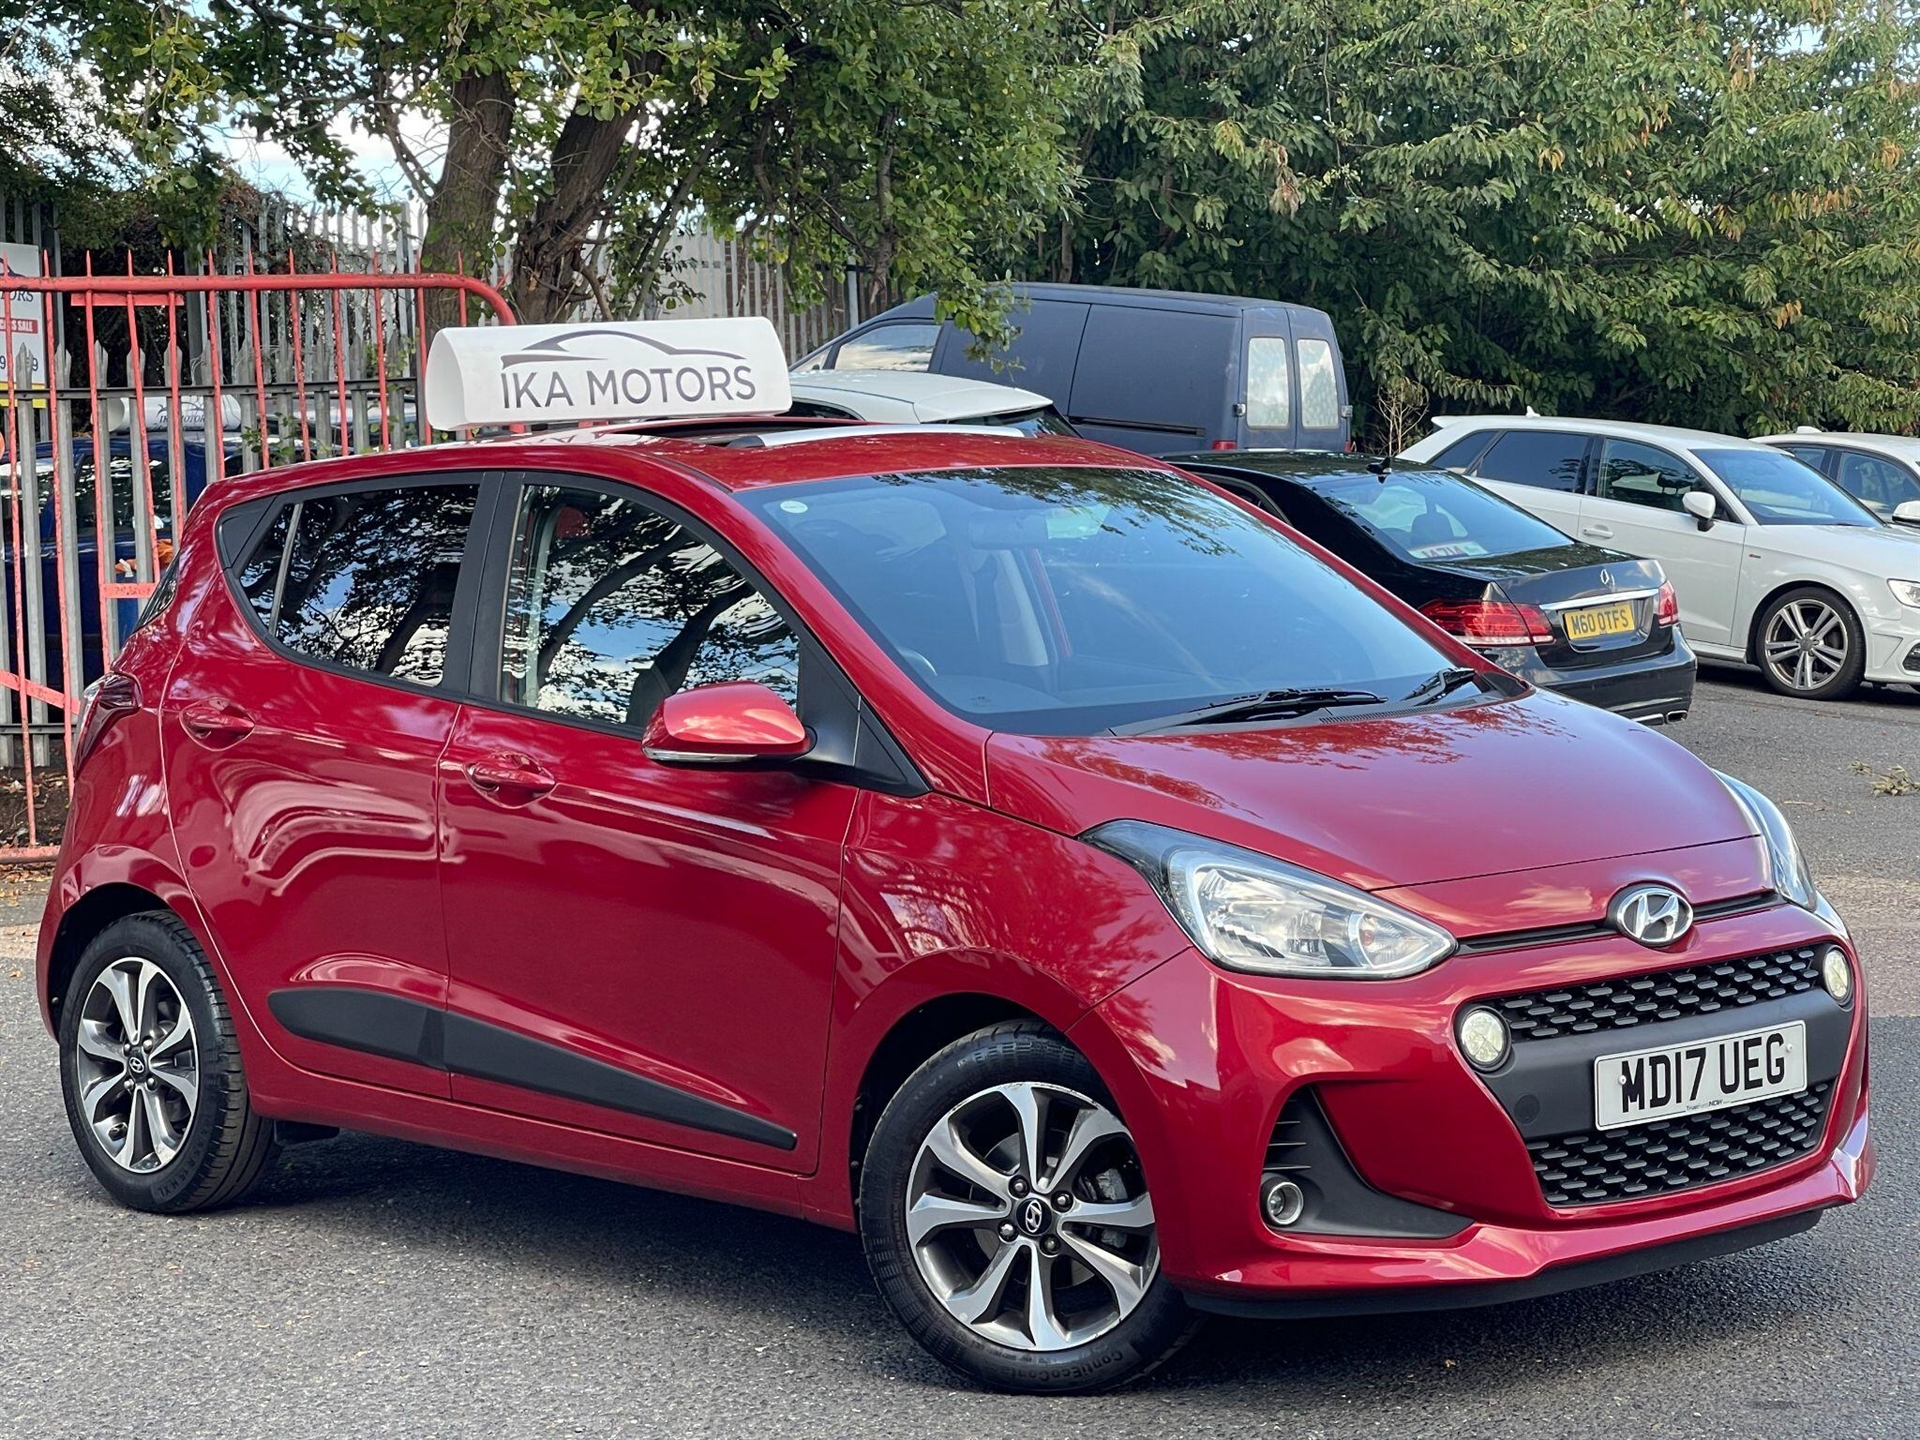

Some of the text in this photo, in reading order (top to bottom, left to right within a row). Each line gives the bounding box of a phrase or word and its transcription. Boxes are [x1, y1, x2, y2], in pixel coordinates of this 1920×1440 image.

[500, 365, 757, 410] IKA MOTORS
[1570, 613, 1596, 636] M60
[1620, 1032, 1786, 1114] MD17 UEG
